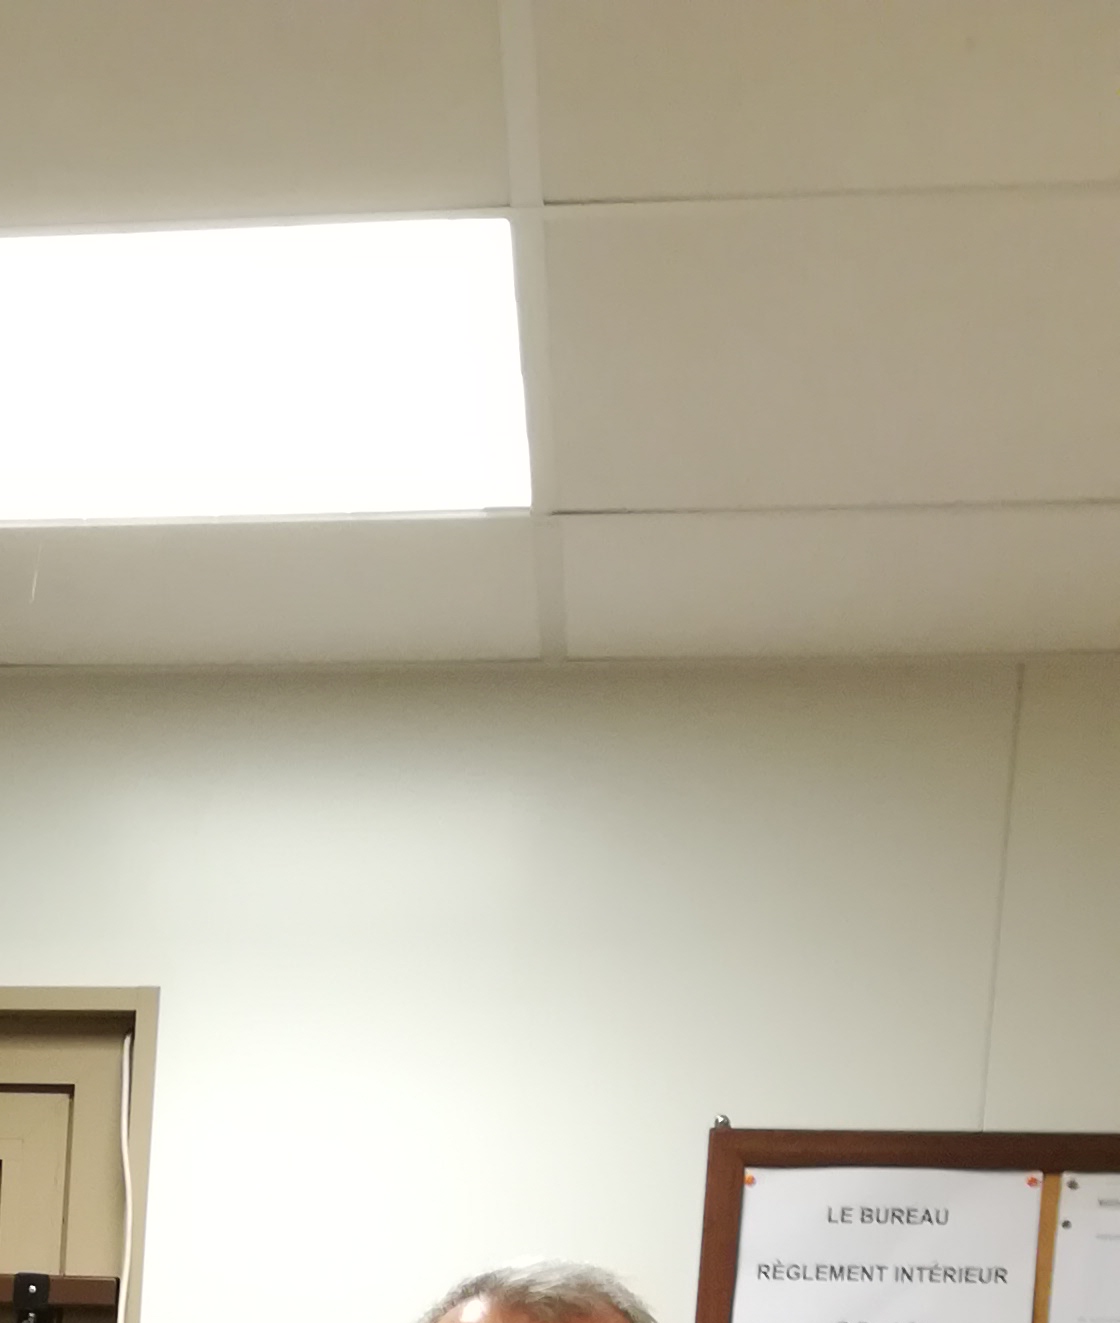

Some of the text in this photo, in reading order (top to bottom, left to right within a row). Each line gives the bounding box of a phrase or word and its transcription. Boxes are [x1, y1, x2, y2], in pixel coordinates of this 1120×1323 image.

[827, 1206, 949, 1226] LE BUREAU
[757, 1258, 1008, 1284] RÈGLEMENT INTÉRIEUR
